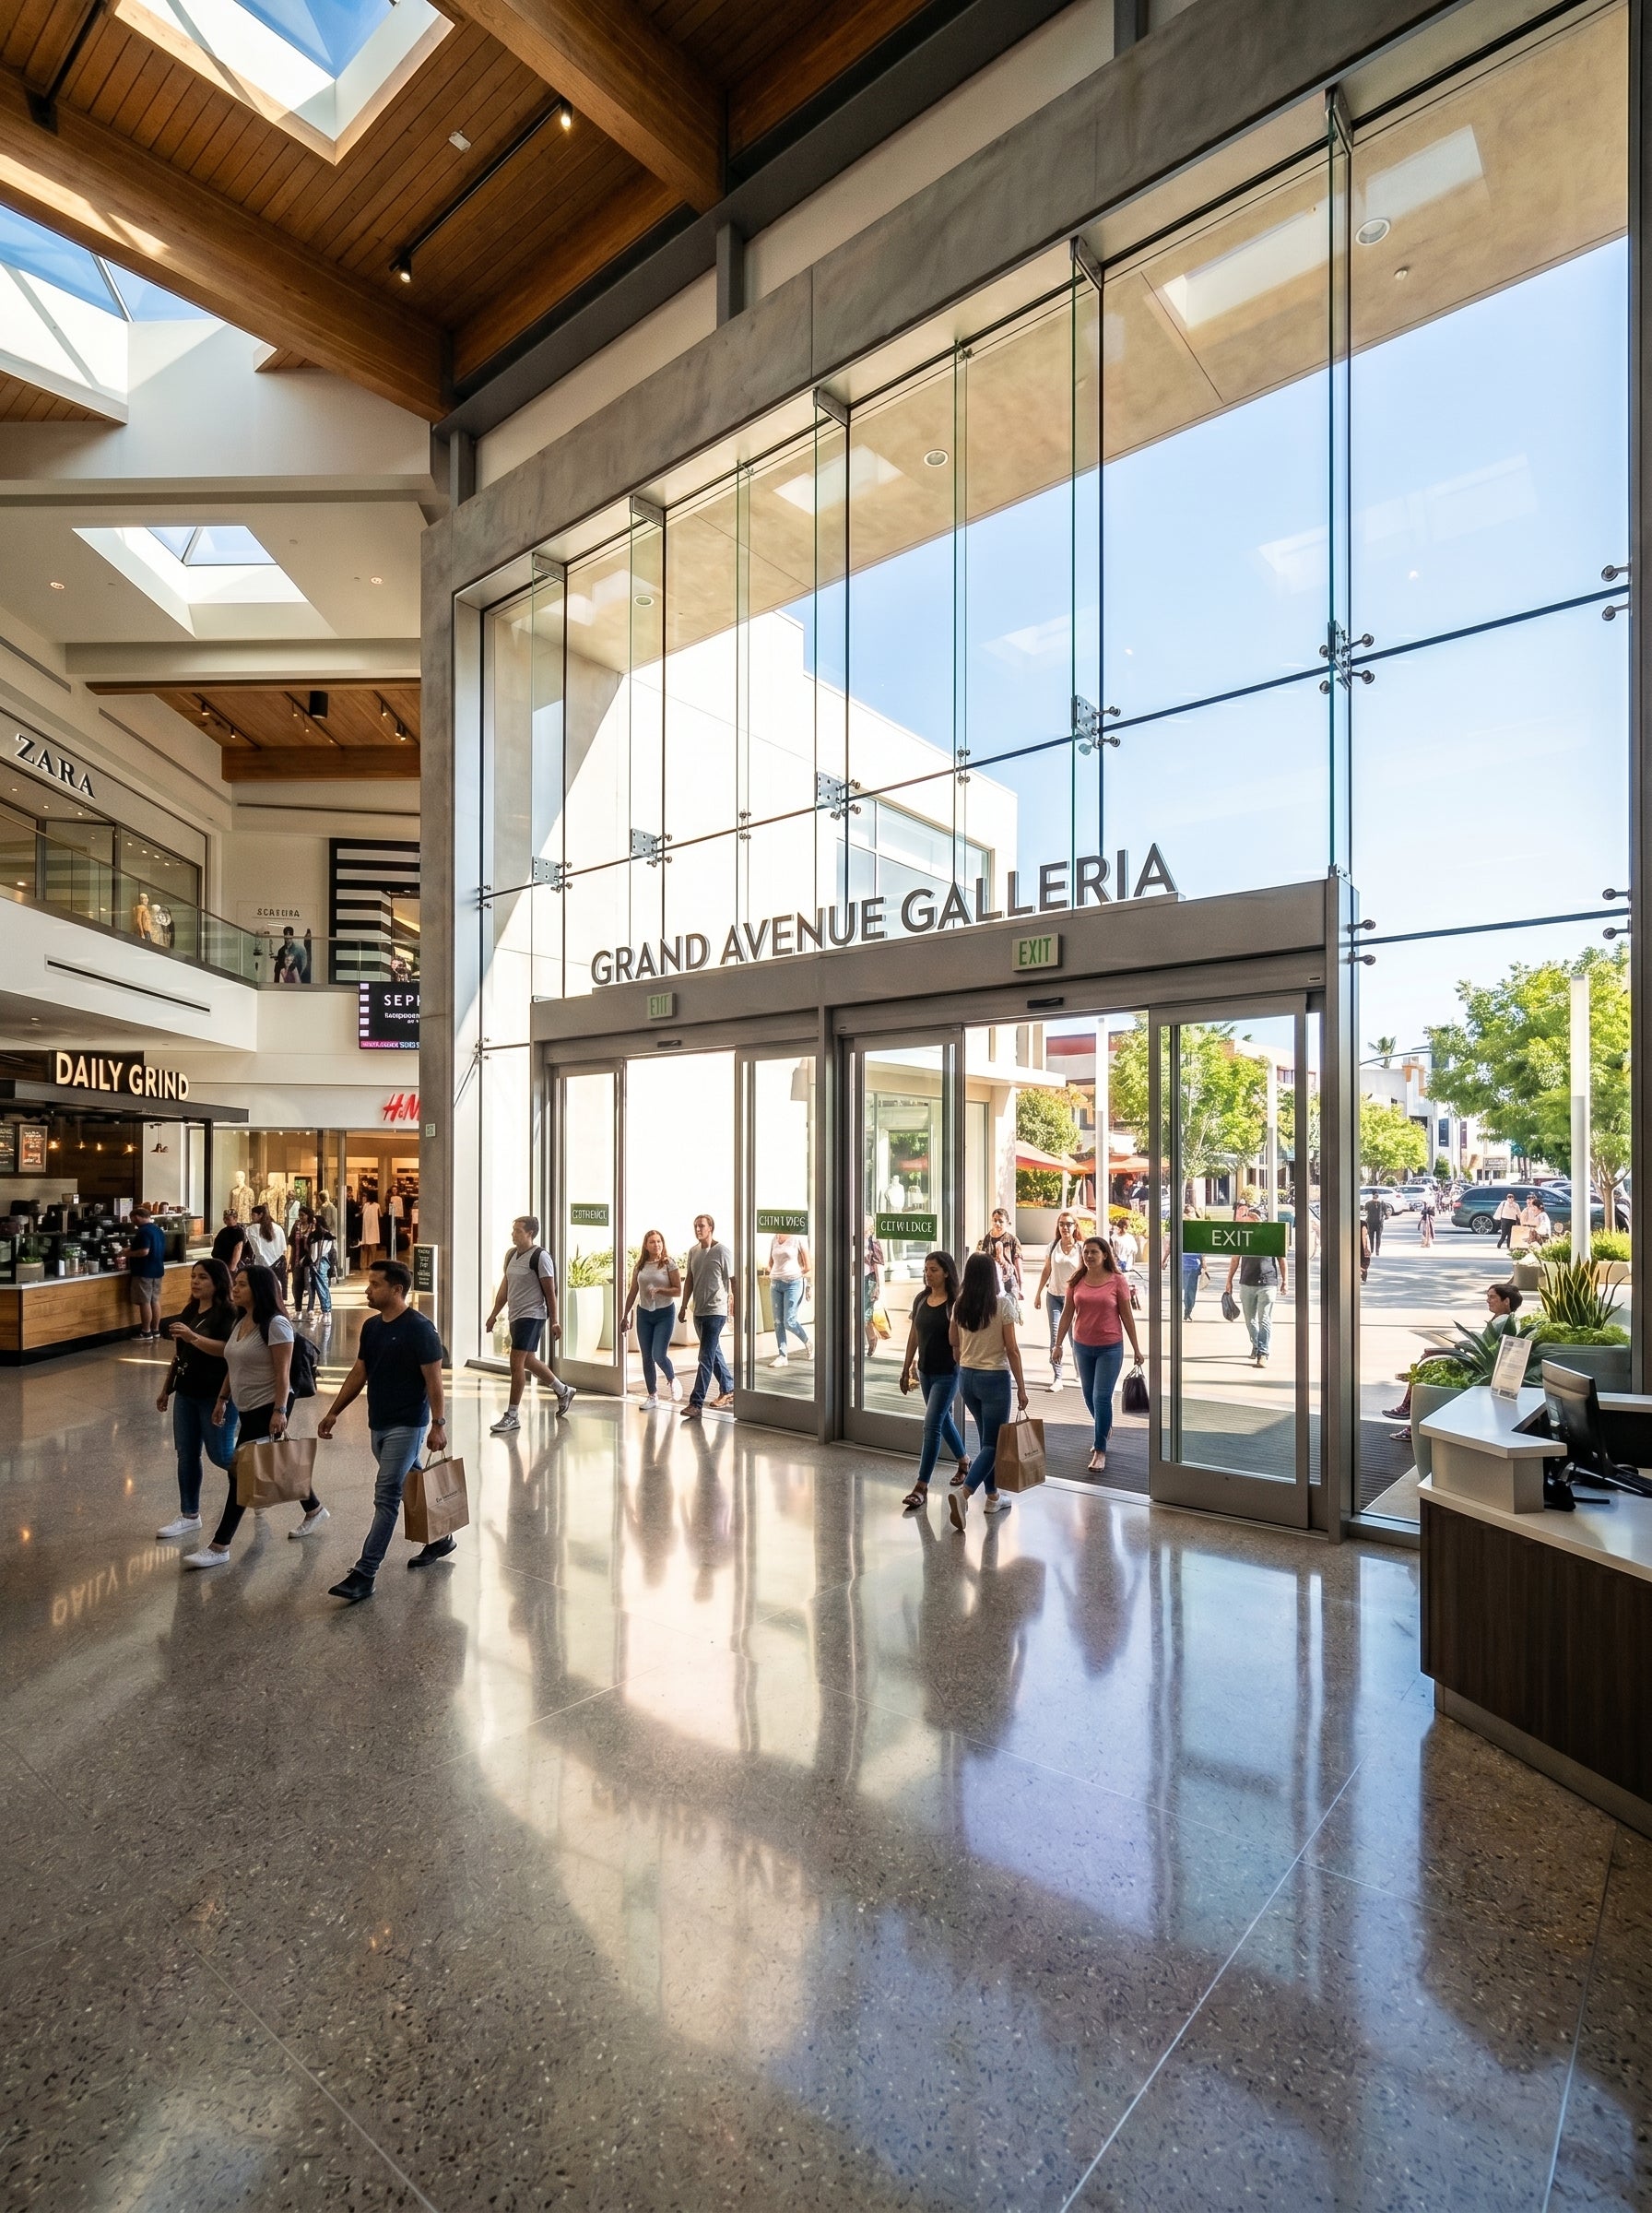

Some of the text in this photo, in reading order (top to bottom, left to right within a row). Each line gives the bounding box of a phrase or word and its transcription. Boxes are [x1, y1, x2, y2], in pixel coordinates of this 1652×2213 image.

[15, 733, 96, 800] ZARA
[591, 842, 1178, 986] GRAND AVENUE GALLERIA
[1019, 937, 1052, 965] EXIT
[55, 1051, 190, 1101] DAILY GRIND
[1211, 1229, 1255, 1248] EXIT
